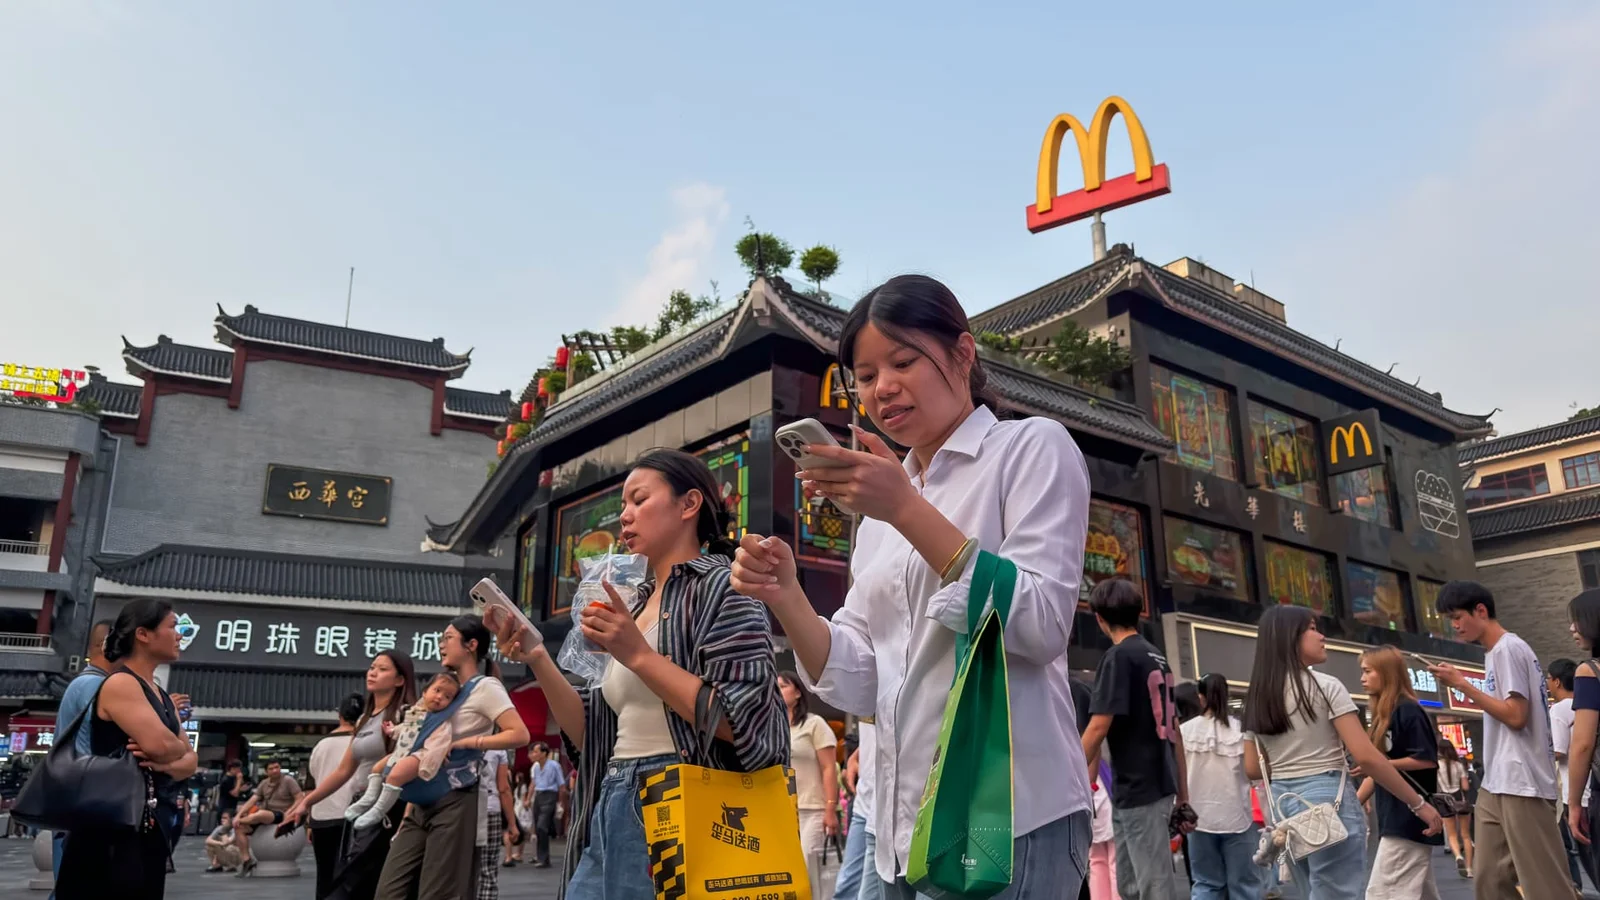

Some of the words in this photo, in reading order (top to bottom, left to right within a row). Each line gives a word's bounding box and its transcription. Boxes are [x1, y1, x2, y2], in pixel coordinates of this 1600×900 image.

[215, 619, 443, 661] 明珠眼镜城
[711, 821, 760, 853] 歪马送酒
